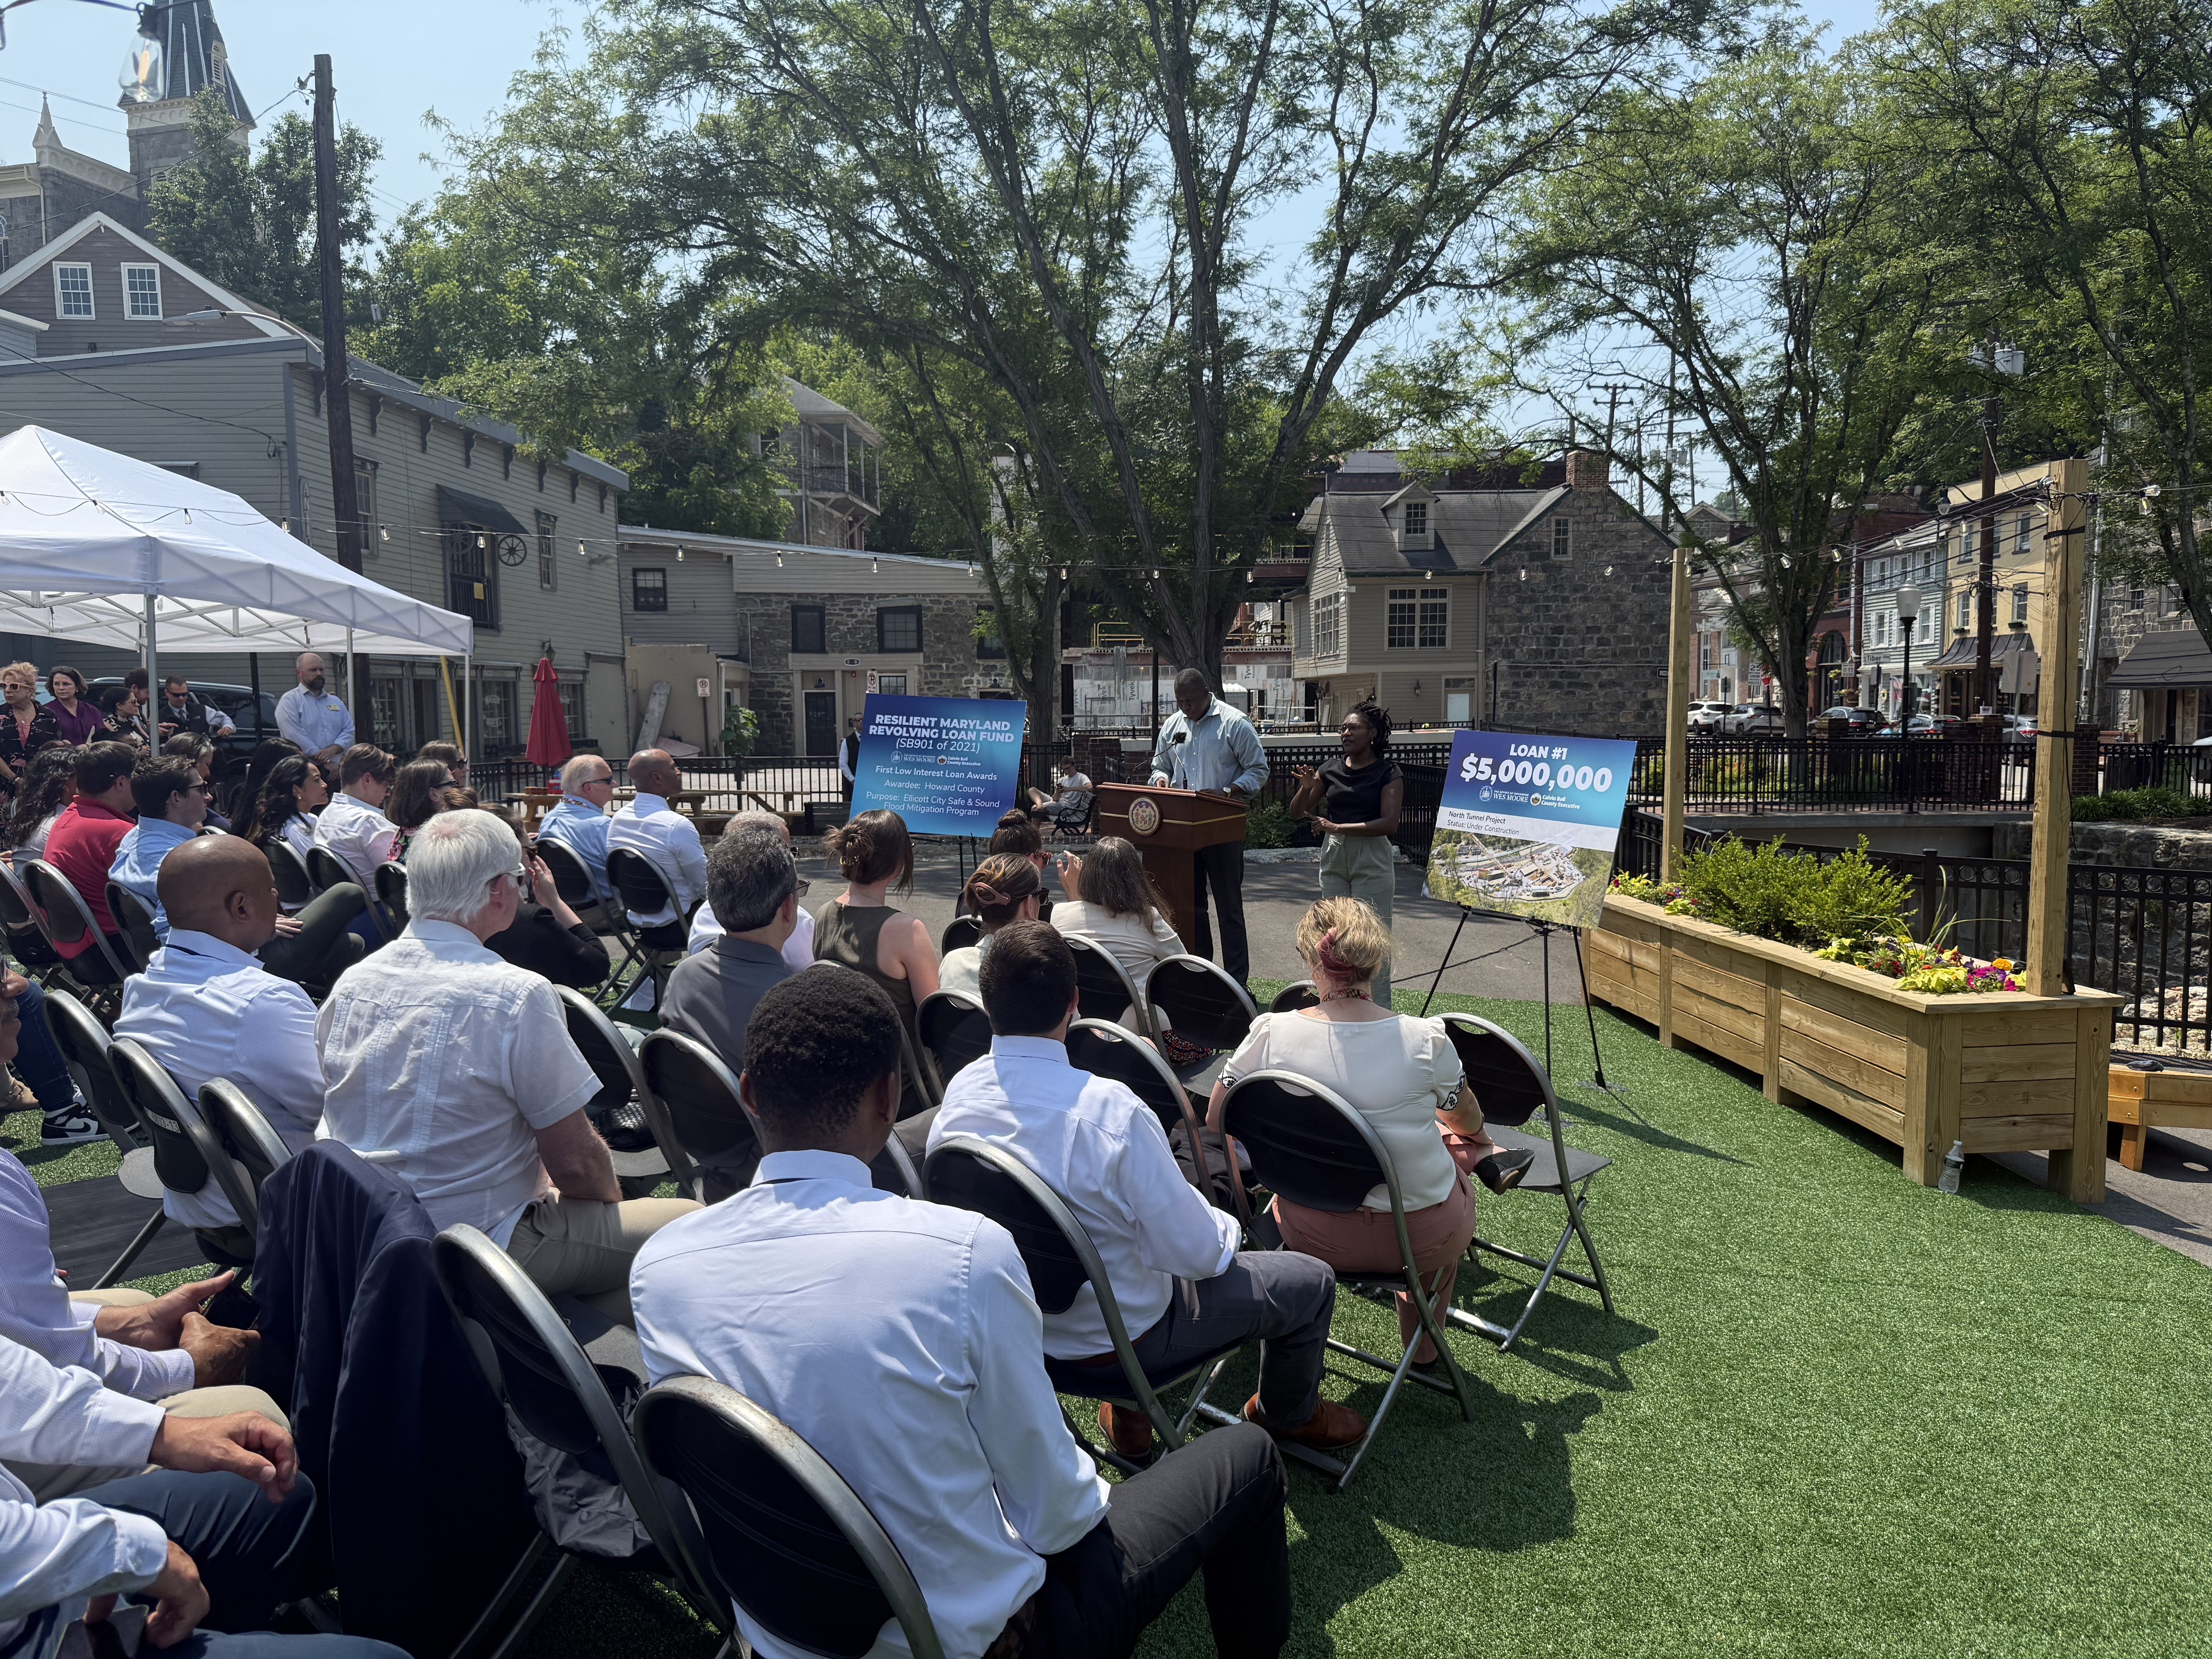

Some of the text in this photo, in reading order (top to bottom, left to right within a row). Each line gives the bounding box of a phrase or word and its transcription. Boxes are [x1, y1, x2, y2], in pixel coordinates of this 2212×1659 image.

[876, 714, 1010, 731] RESILIENT MARYLAND
[869, 725, 1014, 742] REVOLVING LOAN FUND
[896, 738, 980, 754] (SB901 of 2021)
[1510, 744, 1568, 760] LOAN #1
[876, 766, 893, 774] First
[914, 768, 944, 777] Interest
[945, 770, 964, 778] Loan
[966, 771, 997, 780] Awards
[1460, 753, 1612, 792] $5,000,000
[884, 780, 985, 794] Awardee: Howard County
[866, 791, 900, 801] Purpose:
[904, 794, 929, 803] Ellicott
[931, 796, 946, 805] City
[948, 797, 965, 805] Safe
[975, 799, 1000, 807] Sound
[884, 802, 979, 816] Flood Mitigation Program
[1447, 819, 1519, 835] Status: Under Construction
[1486, 816, 1506, 824] Project
